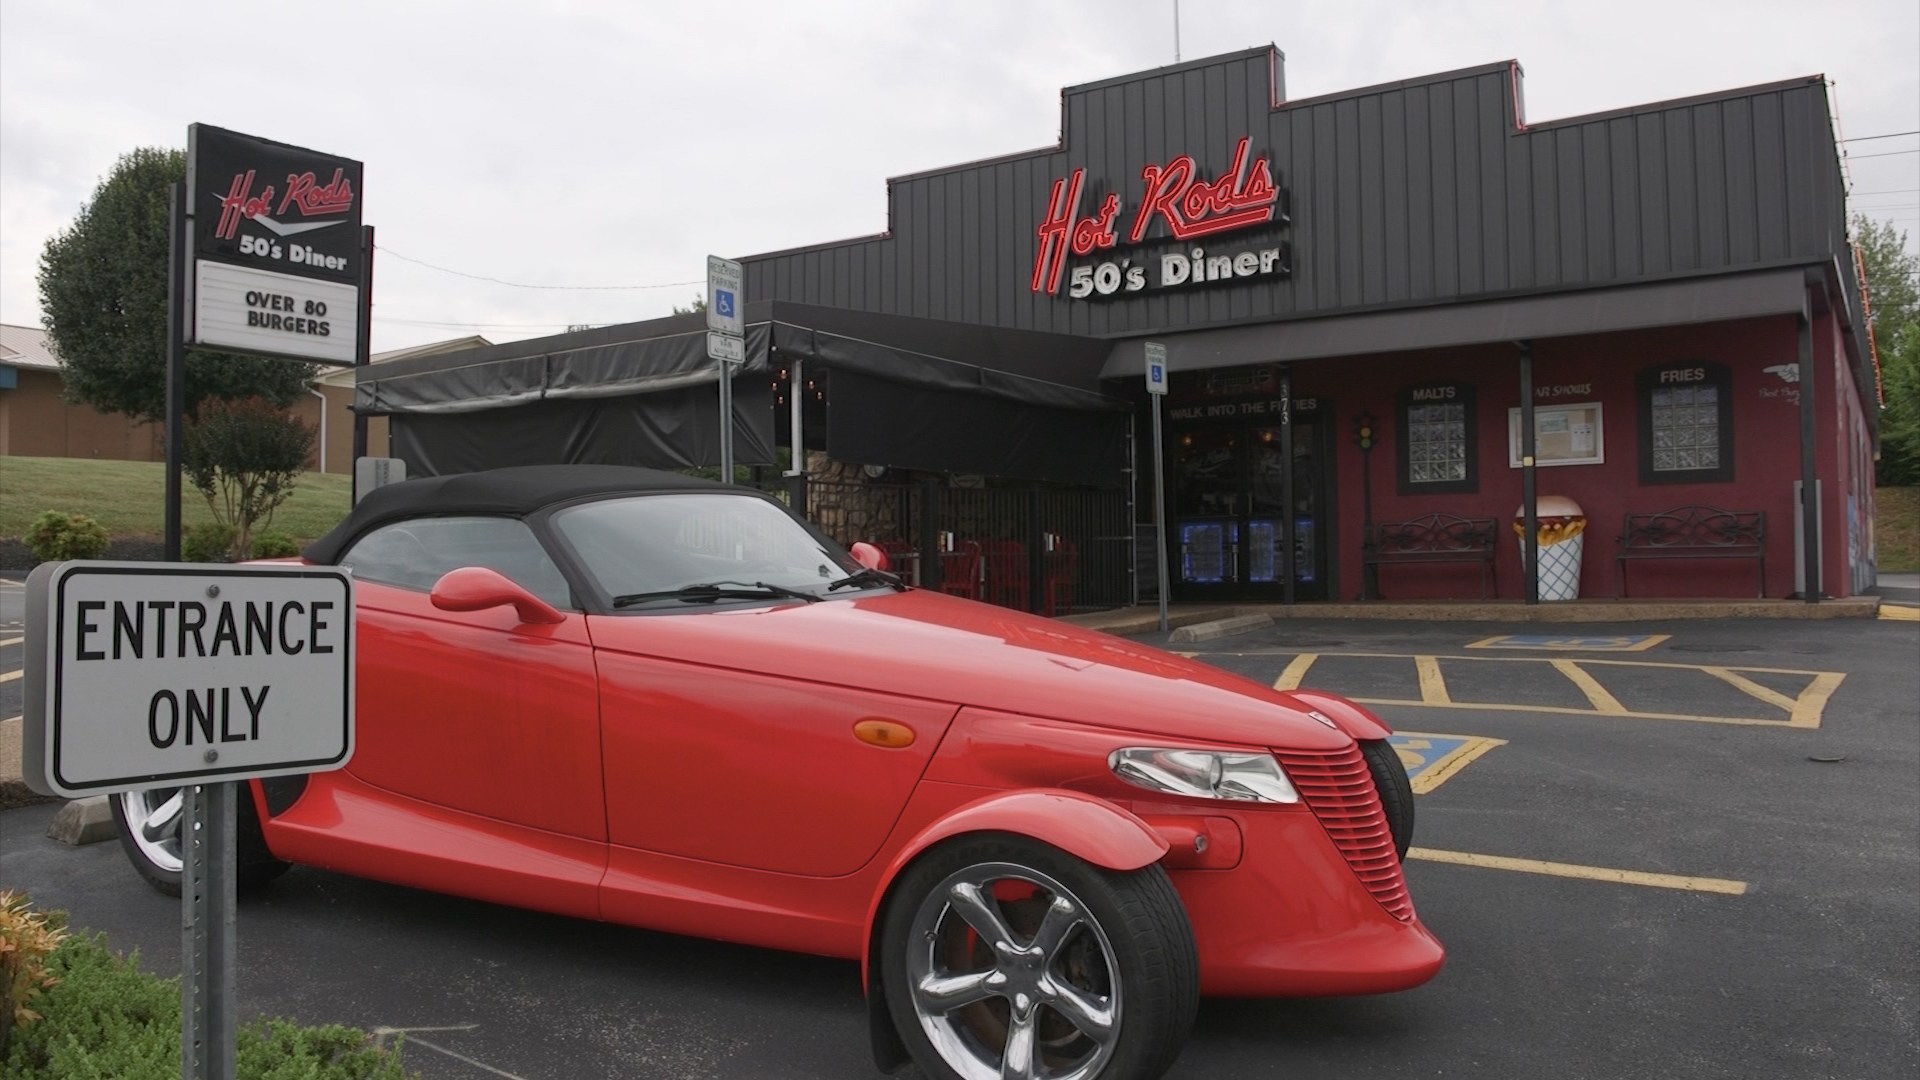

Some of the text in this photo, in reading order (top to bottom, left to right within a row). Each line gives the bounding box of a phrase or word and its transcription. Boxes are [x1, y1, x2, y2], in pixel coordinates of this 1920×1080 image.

[215, 168, 353, 240] Hot Rods
[1030, 136, 1280, 295] Hot Rods
[239, 235, 348, 271] 50's Diner
[1069, 248, 1280, 298] 50's Diner
[246, 291, 327, 316] OVER 80
[248, 310, 330, 337] BURGERS
[1534, 383, 1592, 397] AR SHOWS
[1660, 368, 1705, 383] FRIES
[1413, 386, 1456, 400] MALTS
[1170, 406, 1203, 420] WALK
[1208, 404, 1236, 417] INTO
[1240, 402, 1265, 414] THE
[76, 600, 334, 661] ENTRANCE
[148, 685, 270, 749] ONLY
